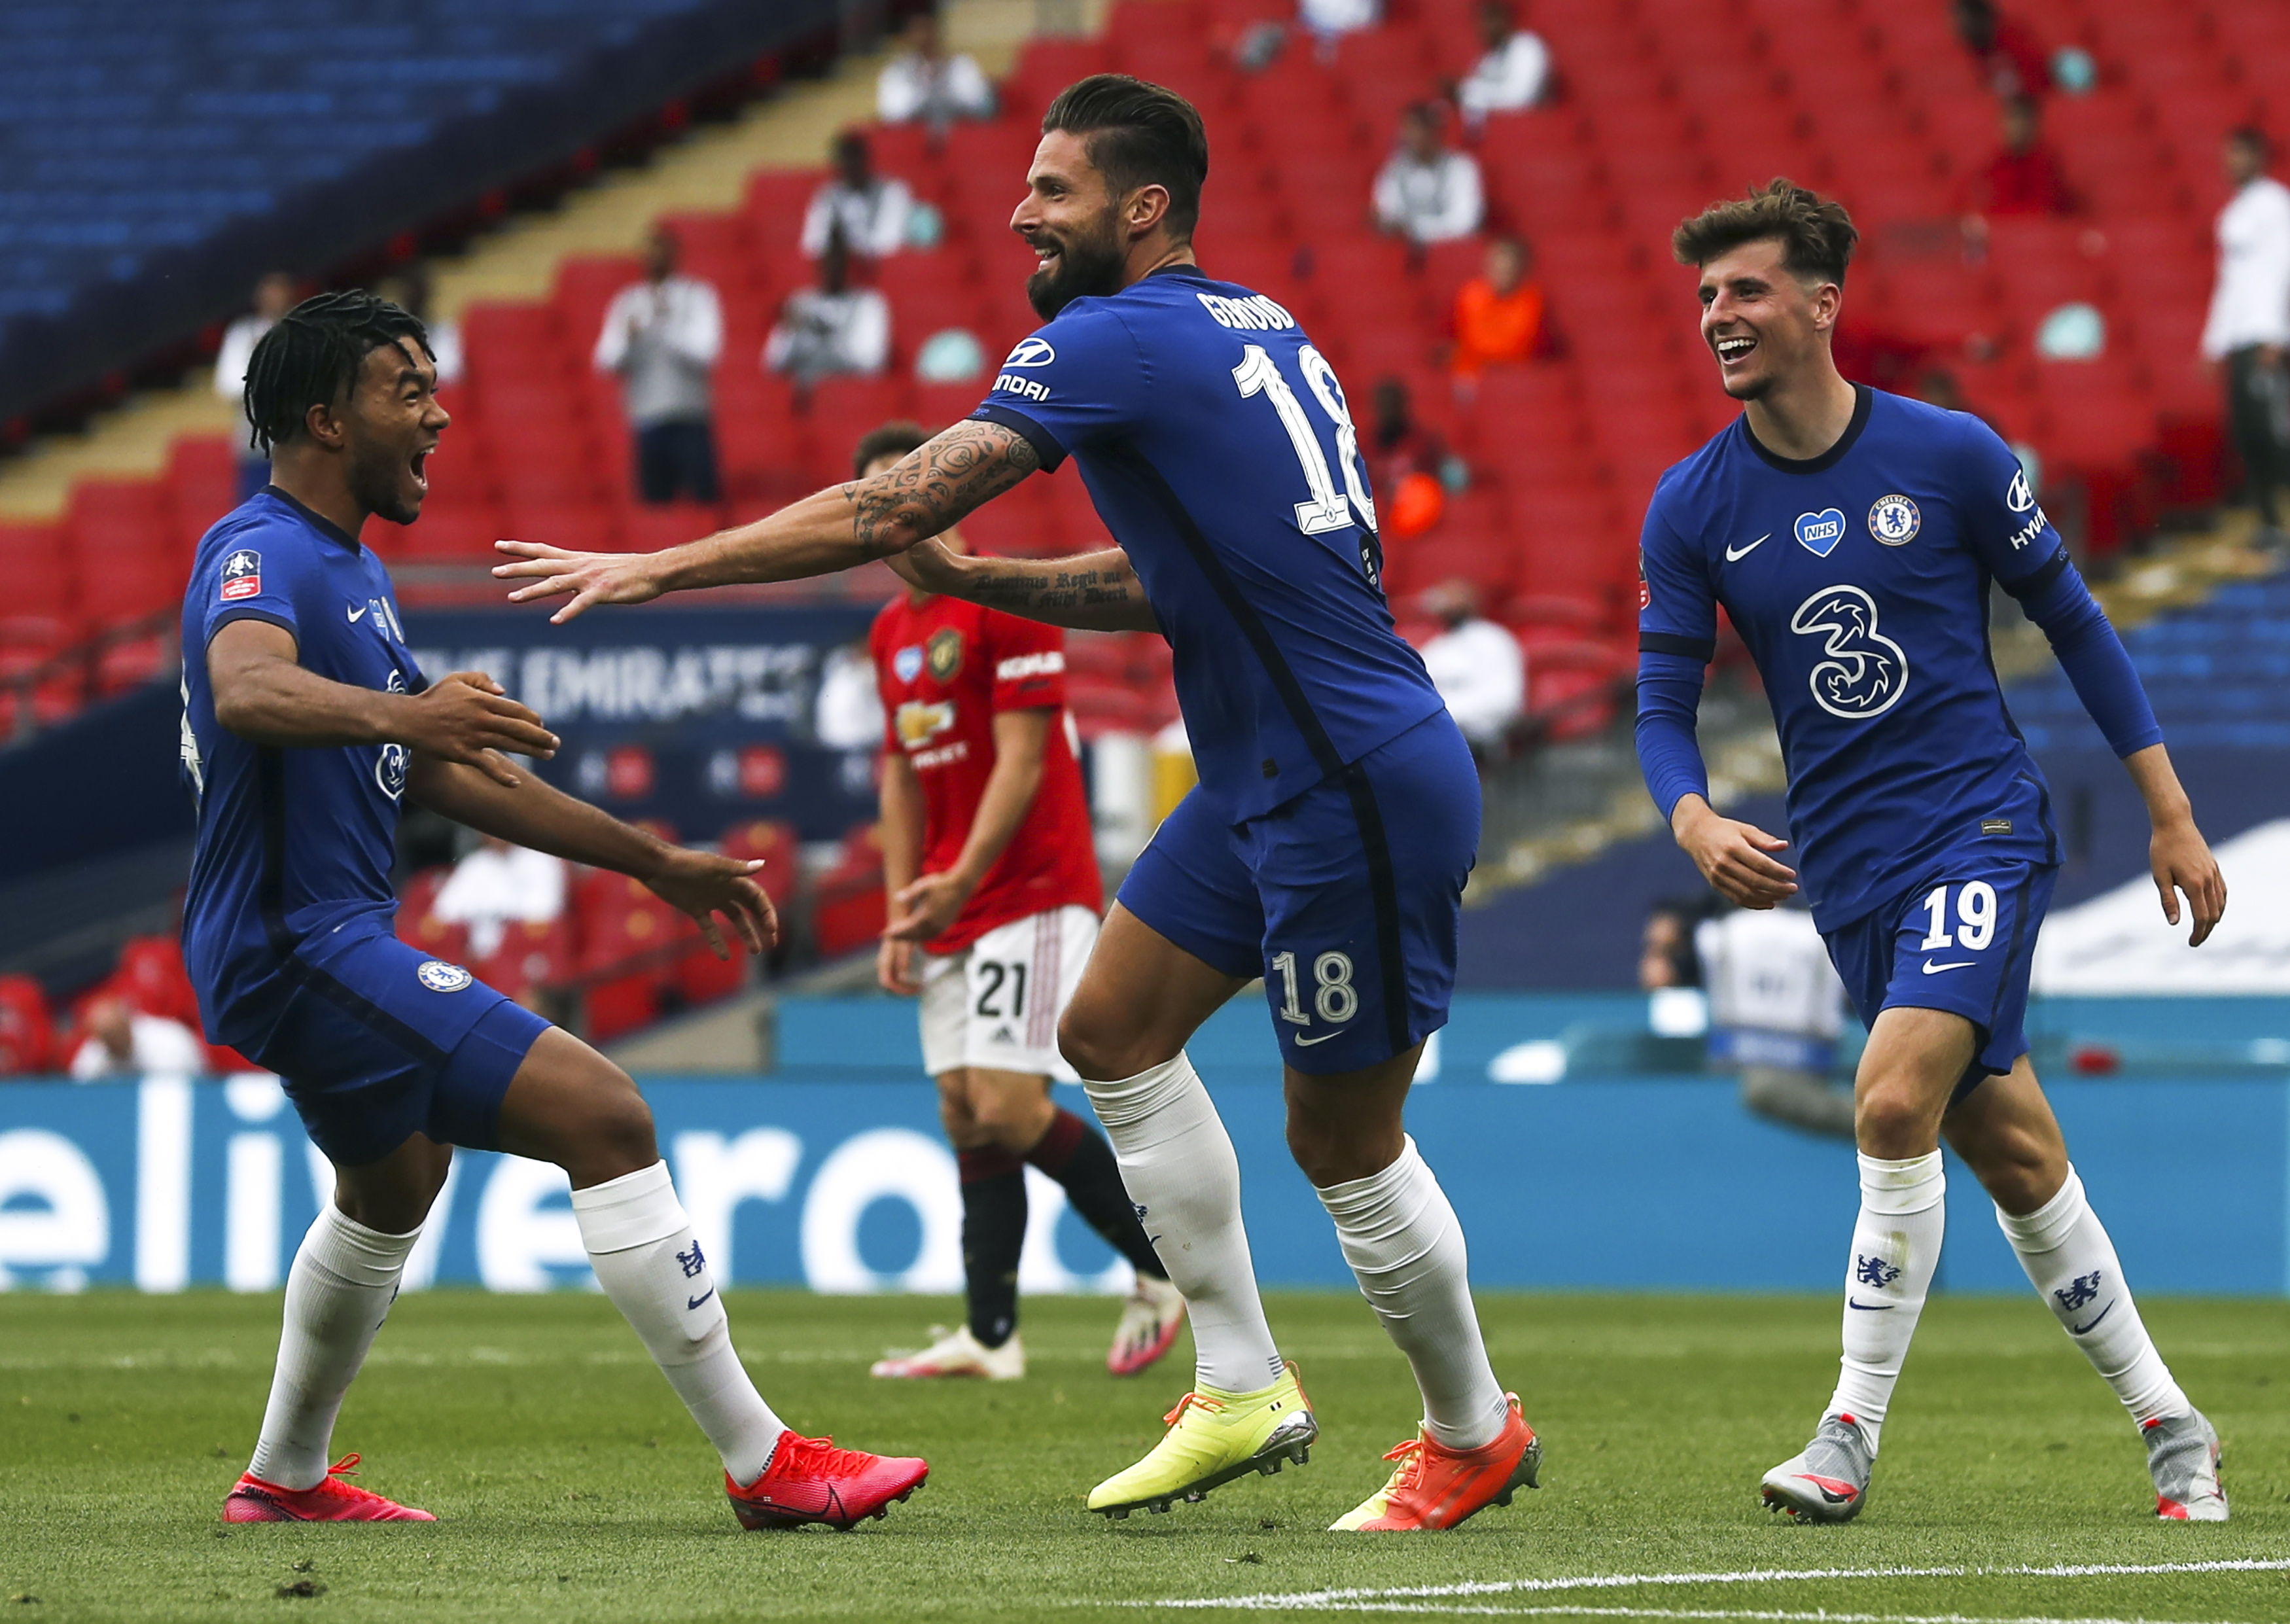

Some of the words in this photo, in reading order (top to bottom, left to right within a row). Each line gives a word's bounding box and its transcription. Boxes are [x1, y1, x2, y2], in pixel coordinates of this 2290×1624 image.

[1196, 292, 1295, 331] GIROUD
[1875, 496, 1908, 510] CHELSEA
[1806, 523, 1835, 540] NHS
[1919, 879, 1998, 952] 19
[975, 961, 1027, 1018] 21
[1271, 950, 1360, 1026] 18
